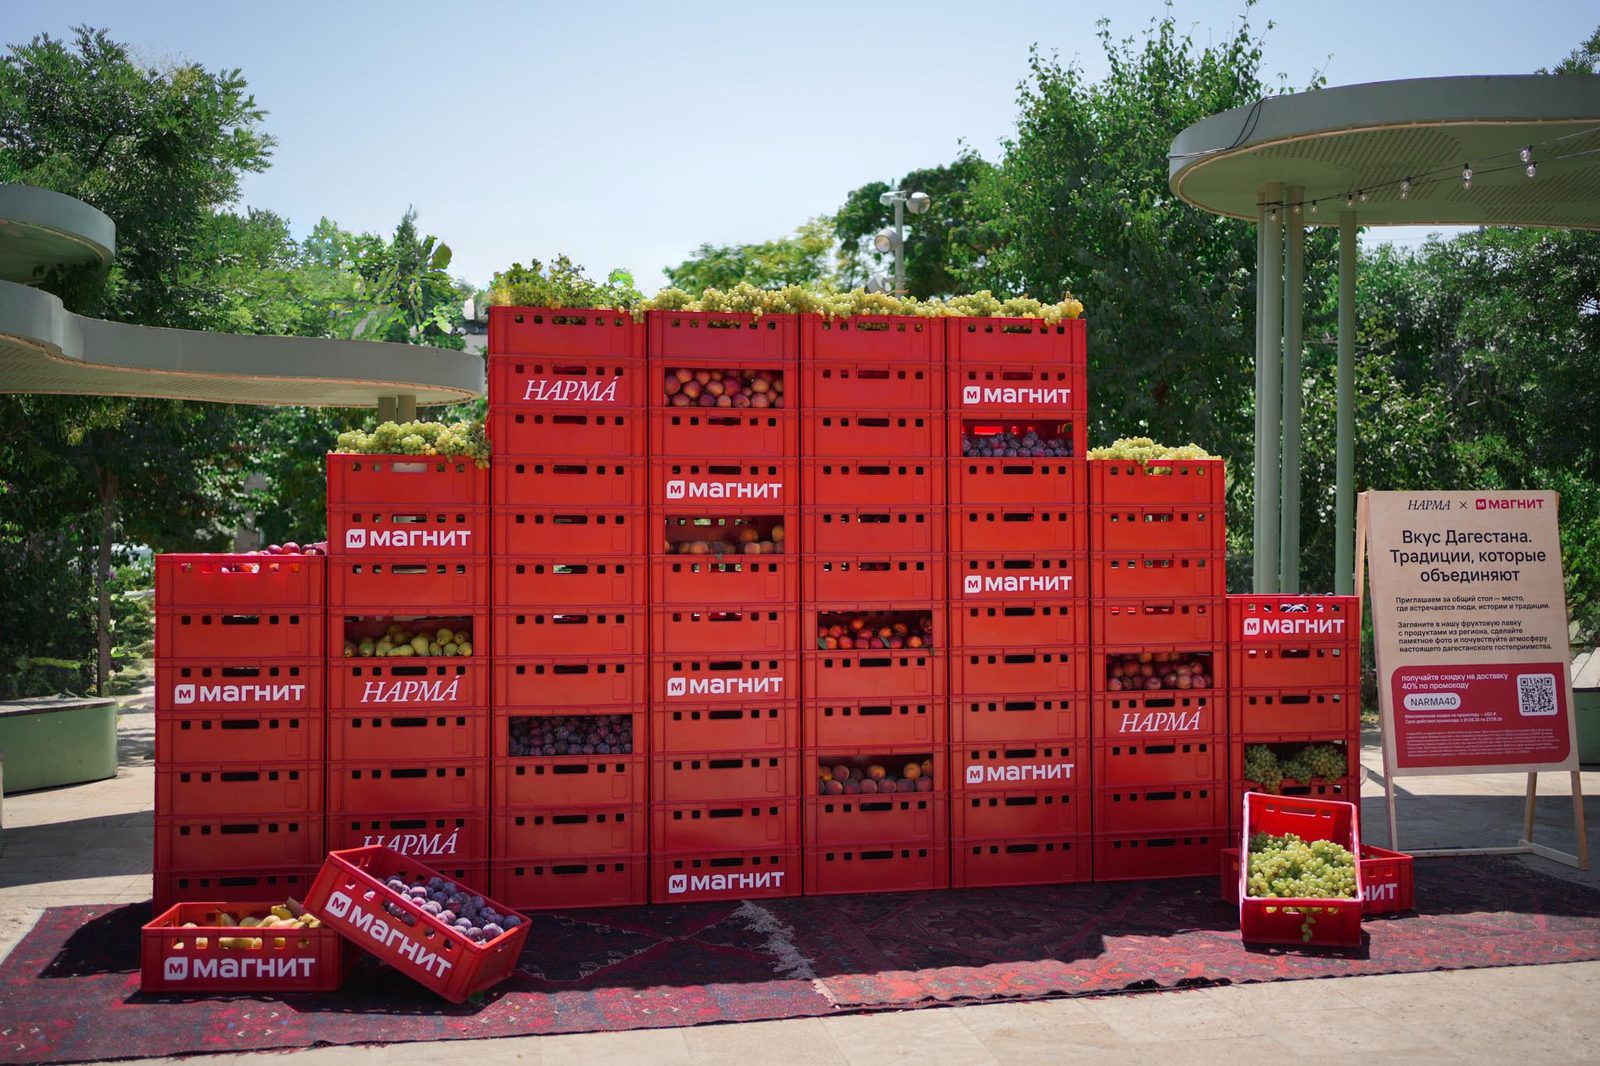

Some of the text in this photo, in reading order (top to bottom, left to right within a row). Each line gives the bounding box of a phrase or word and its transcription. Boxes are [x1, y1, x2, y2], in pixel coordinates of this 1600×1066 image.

[1402, 530, 1532, 547] Вкус Дагестана.
[1390, 549, 1546, 566] Традиции, которые
[1420, 568, 1520, 584] объединяют
[1396, 597, 1441, 605] Приглашаем
[1451, 595, 1476, 603] общий
[1515, 603, 1551, 611] традиции.
[1397, 621, 1434, 629] Загляните
[1490, 627, 1523, 635] сделайте
[1434, 637, 1452, 645] фото
[1460, 636, 1508, 644] почувствуйте
[1494, 644, 1552, 652] гостеприимства.
[1401, 674, 1439, 682] получайте
[1476, 673, 1509, 681] доставку
[1410, 697, 1457, 706] NARMA40
